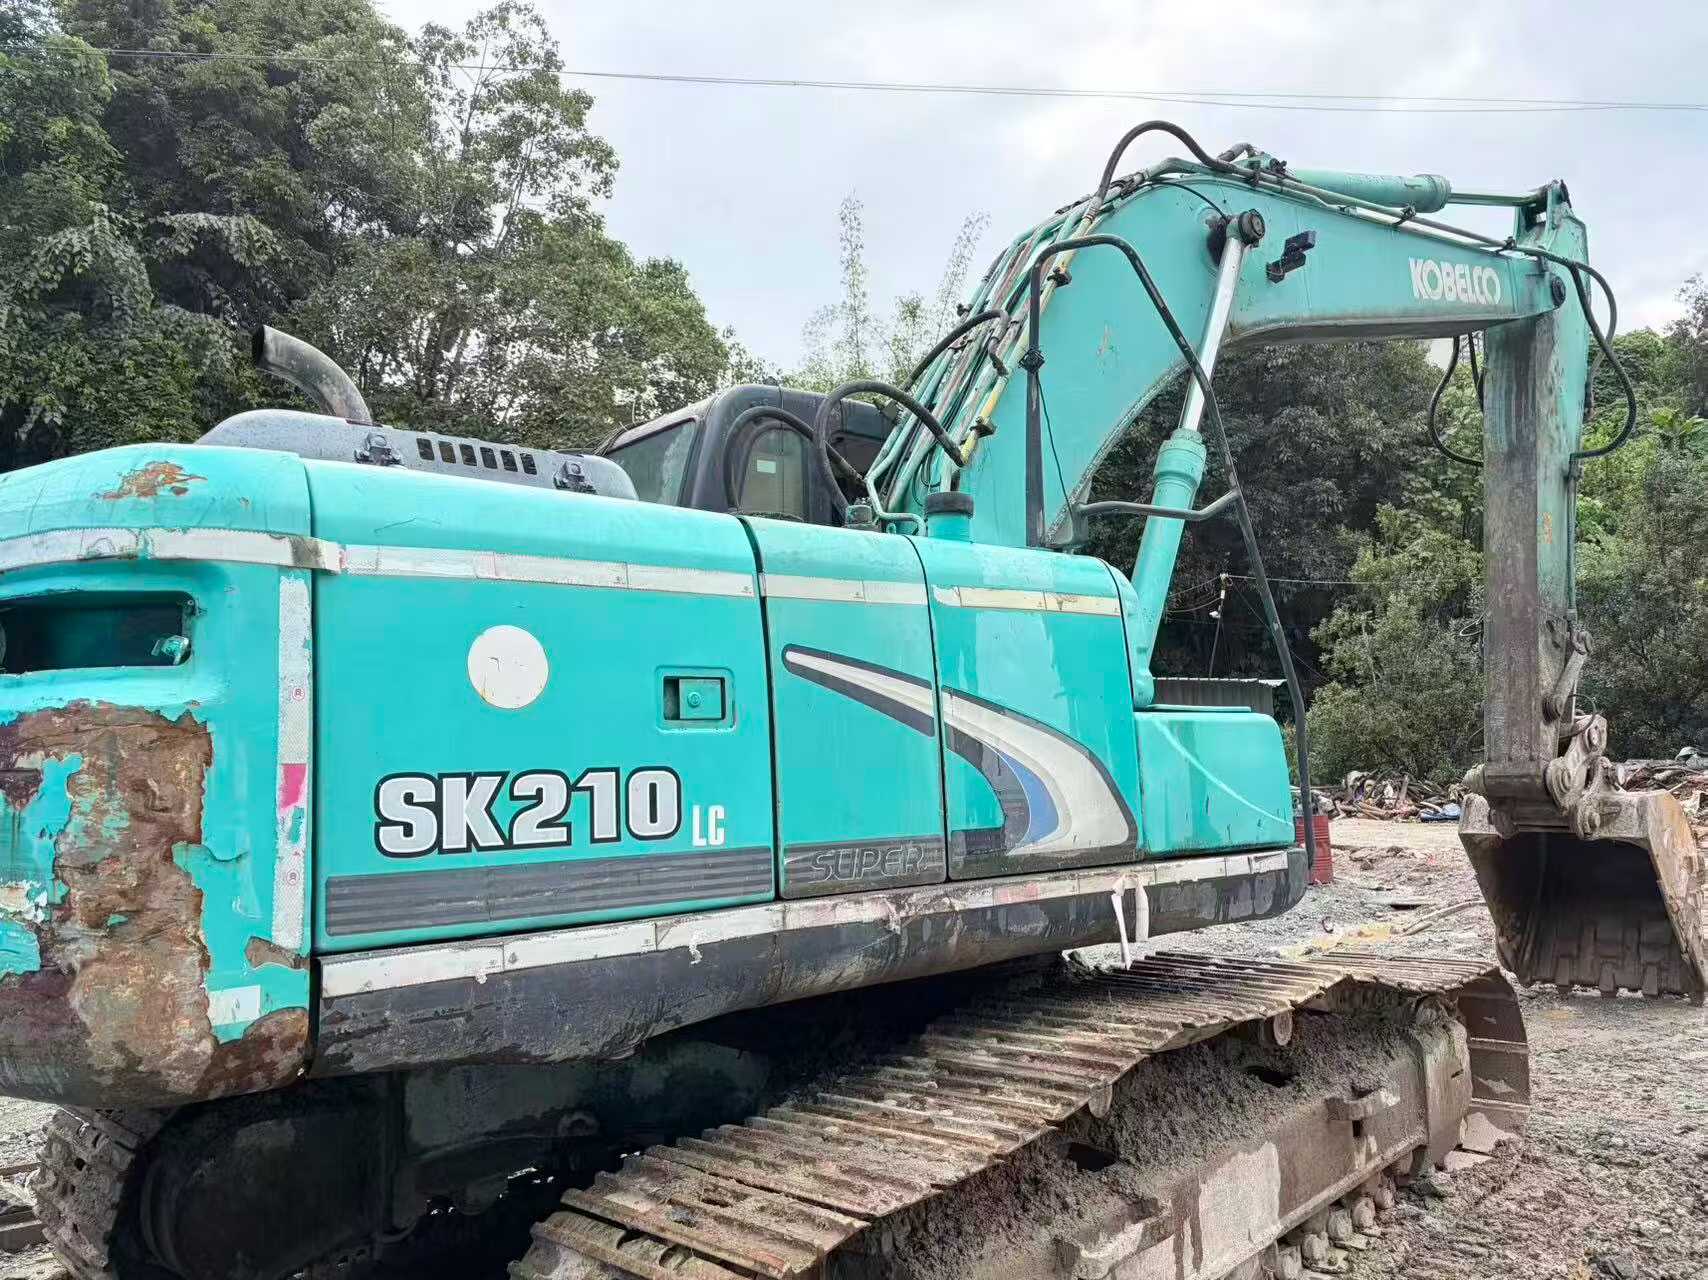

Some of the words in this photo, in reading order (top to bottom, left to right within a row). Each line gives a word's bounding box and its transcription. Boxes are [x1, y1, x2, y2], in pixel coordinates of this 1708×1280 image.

[1408, 256, 1501, 304] KOBELCO
[375, 766, 681, 858] SK210
[692, 805, 725, 847] LC
[809, 844, 928, 884] SUPER
